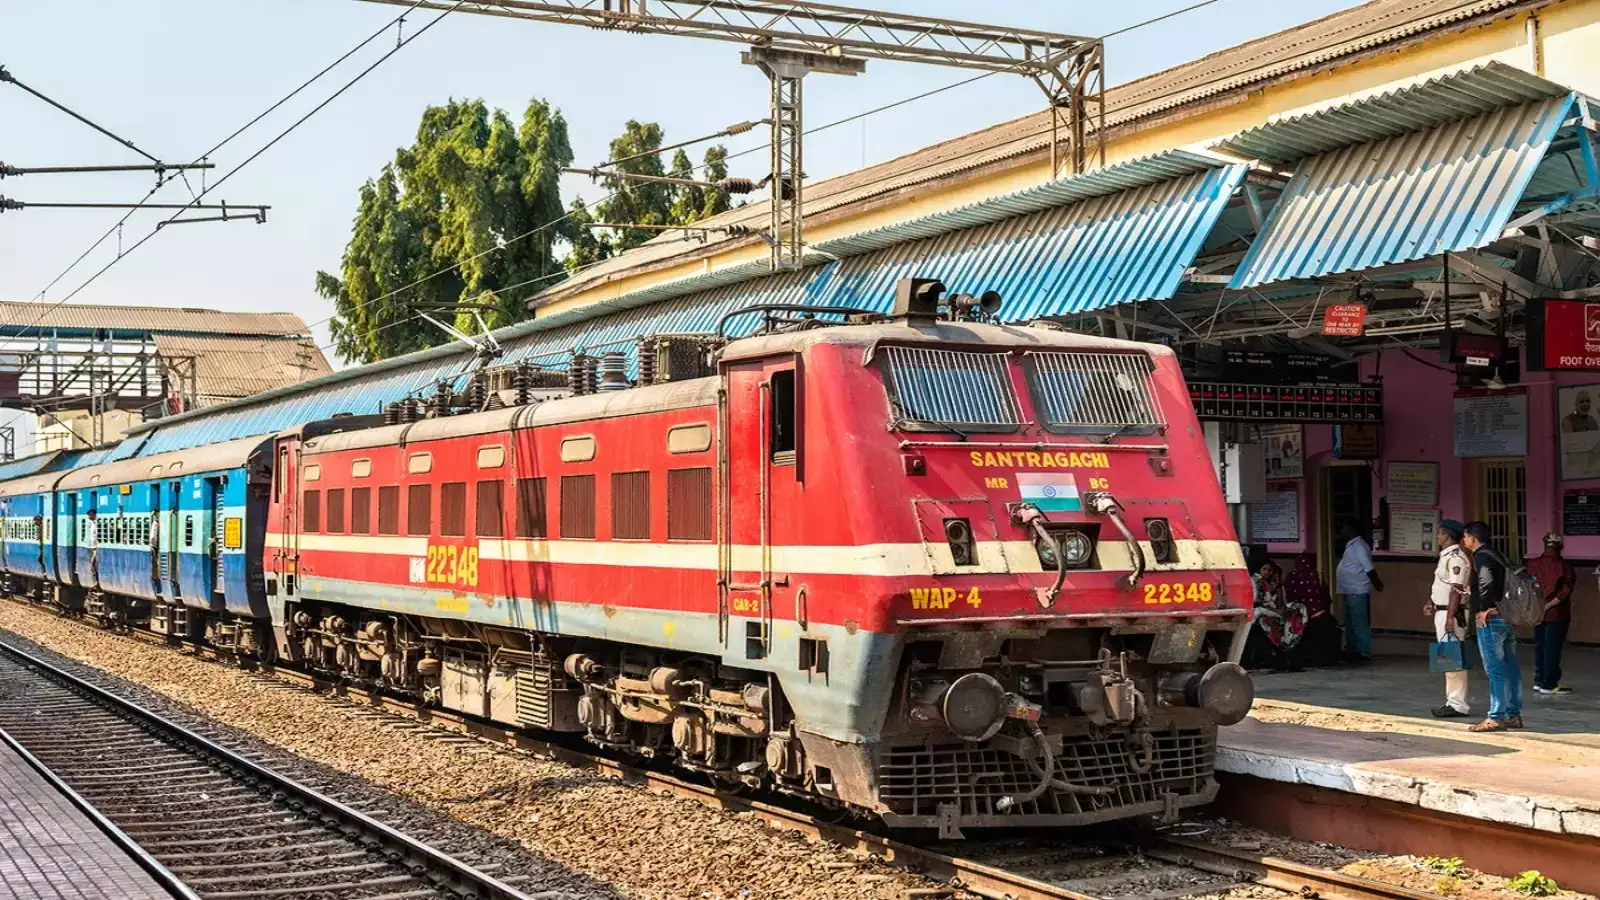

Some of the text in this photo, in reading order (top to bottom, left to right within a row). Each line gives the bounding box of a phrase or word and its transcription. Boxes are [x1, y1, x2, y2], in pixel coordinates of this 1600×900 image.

[1560, 356, 1583, 365] FOOT
[970, 451, 1110, 468] SANTRAGACHI
[984, 477, 1109, 489] MR BG
[427, 545, 478, 587] 22348
[1144, 582, 1213, 604] 22348
